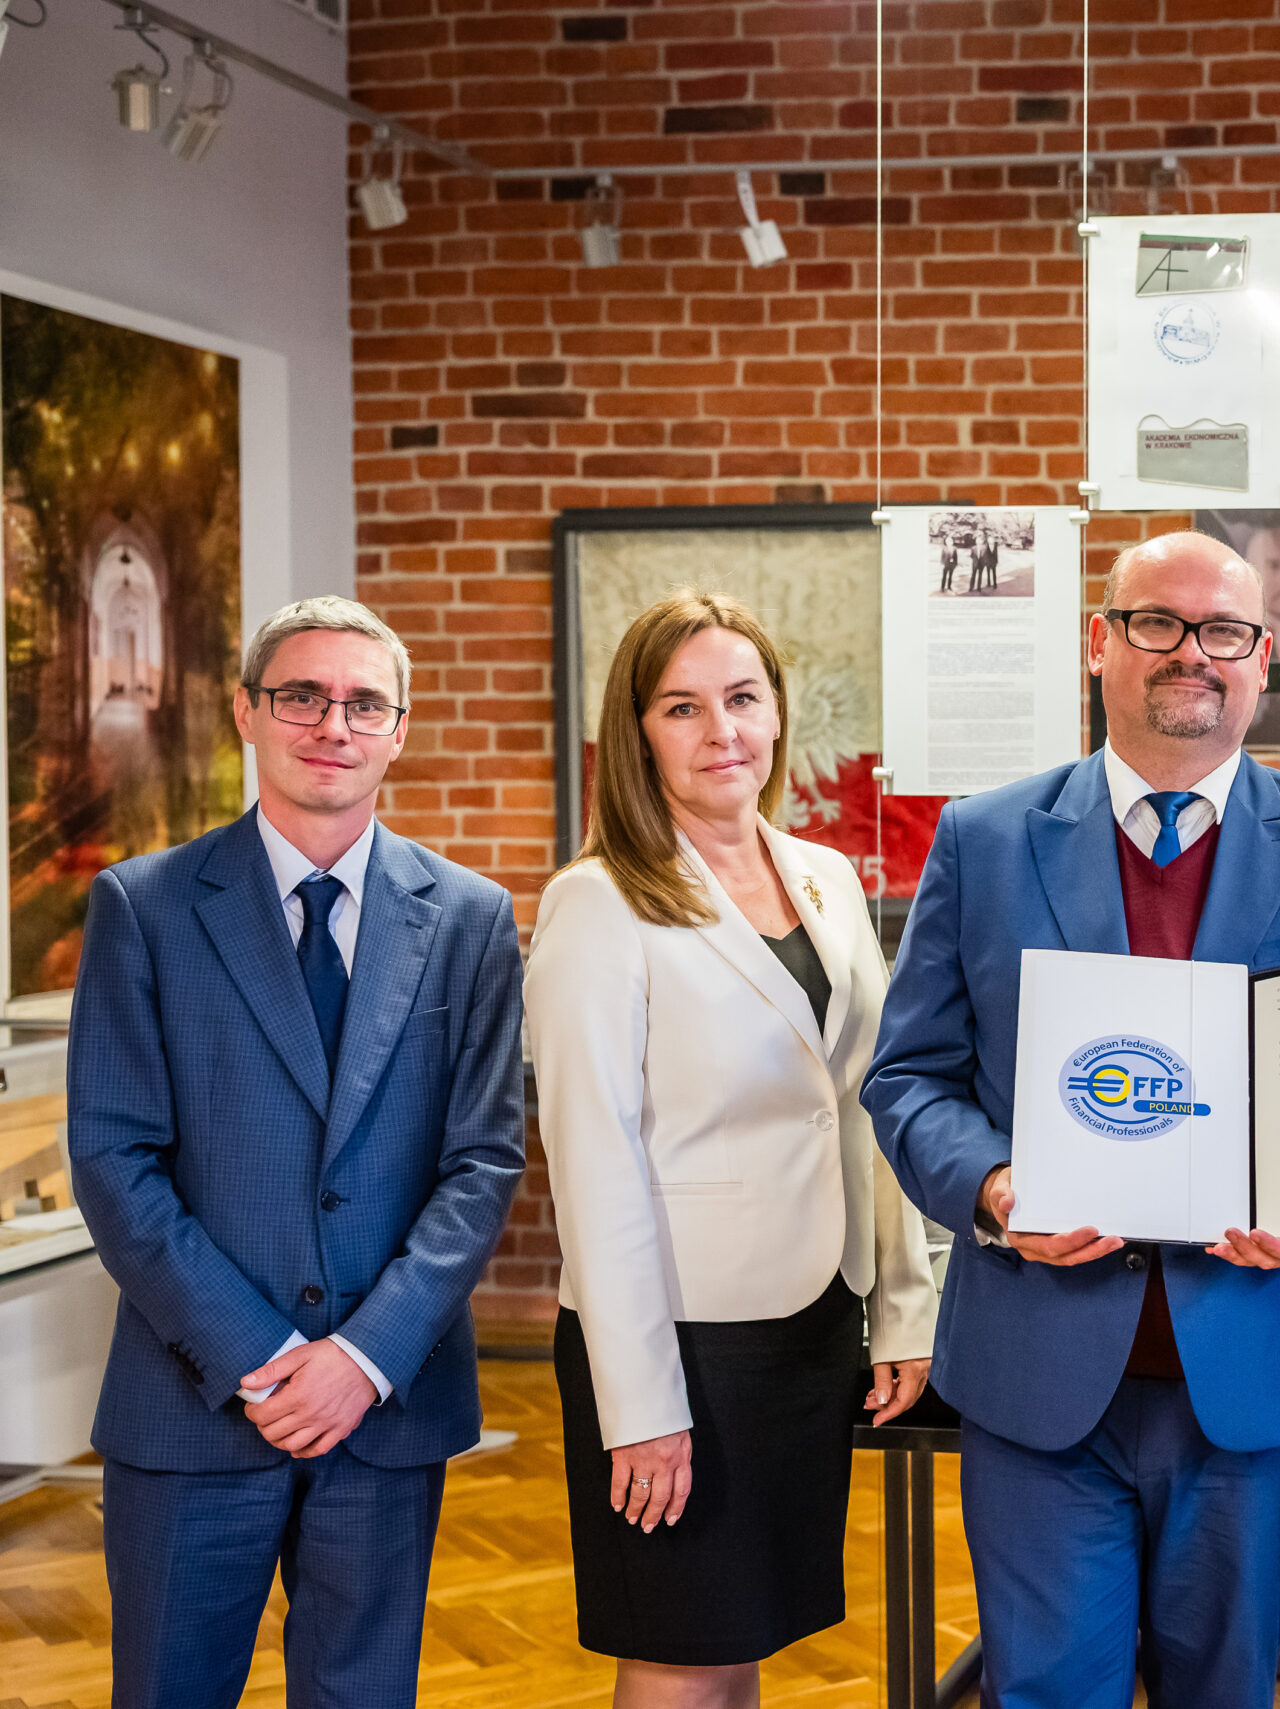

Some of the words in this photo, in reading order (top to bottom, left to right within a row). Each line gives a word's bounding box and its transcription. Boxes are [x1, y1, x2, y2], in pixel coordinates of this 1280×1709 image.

[1121, 1039, 1173, 1064] Federation
[1172, 1062, 1185, 1073] of
[1068, 1097, 1105, 1131] Financial
[1106, 1116, 1173, 1136] Professionals
[1149, 1102, 1195, 1114] POLAND
